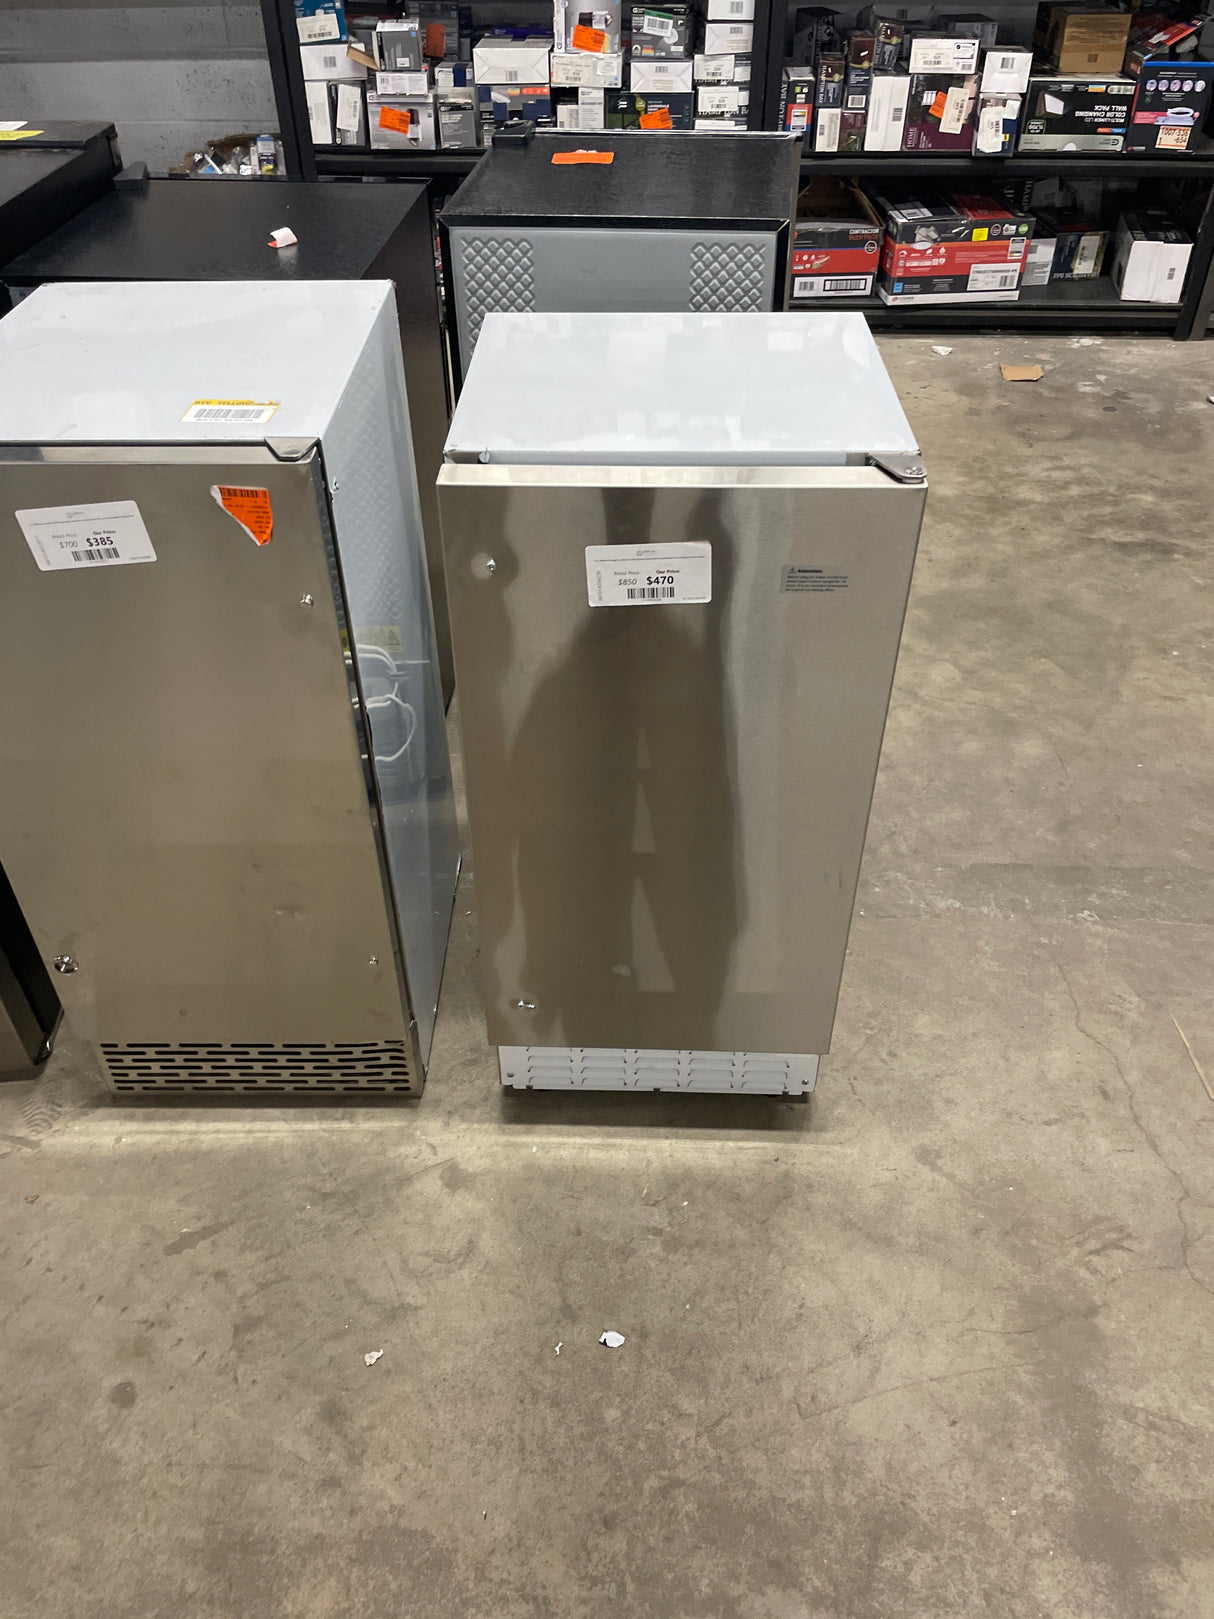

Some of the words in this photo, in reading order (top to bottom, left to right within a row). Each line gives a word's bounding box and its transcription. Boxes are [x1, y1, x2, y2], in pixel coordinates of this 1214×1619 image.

[819, 65, 827, 92] HAMPTON
[780, 84, 788, 99] BAY
[59, 540, 78, 549] $700
[86, 536, 114, 547] $385
[618, 578, 638, 586] $850
[646, 575, 675, 586] $470
